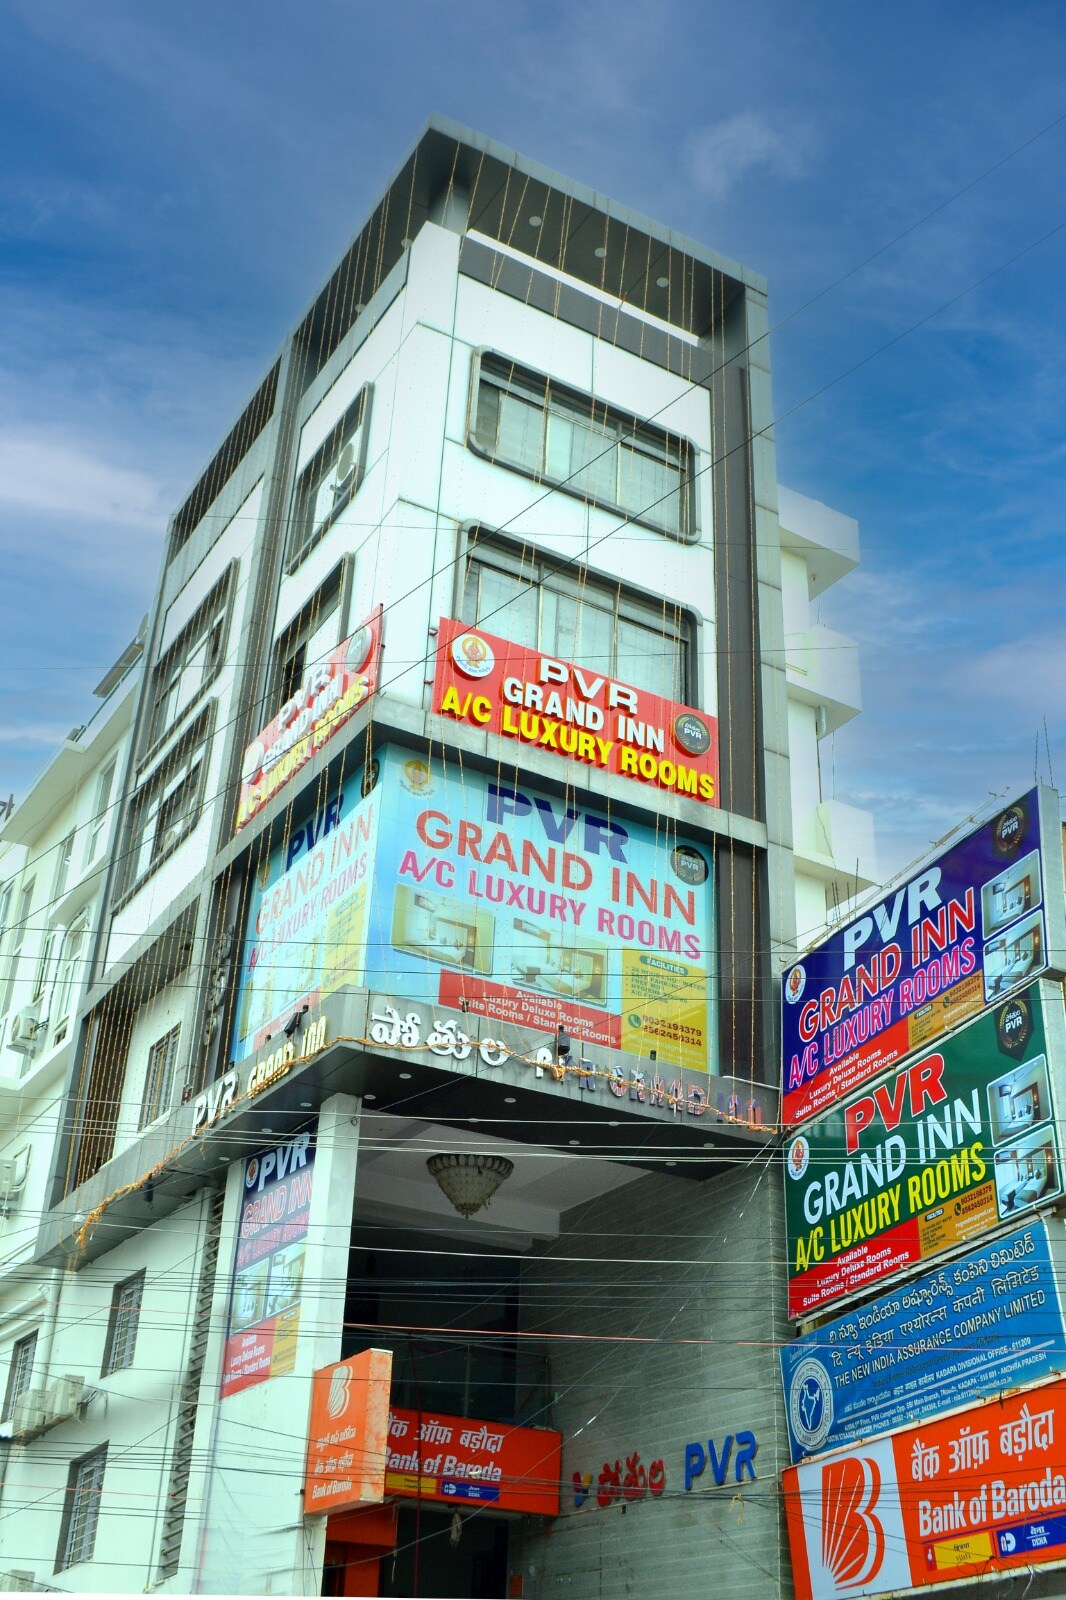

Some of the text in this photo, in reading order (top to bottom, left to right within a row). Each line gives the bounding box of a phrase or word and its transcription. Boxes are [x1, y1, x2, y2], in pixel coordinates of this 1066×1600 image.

[502, 677, 665, 753] GRAND INN
[540, 658, 638, 715] PVR
[441, 686, 715, 800] A/C LUXURY ROOMS
[684, 728, 702, 740] PVR
[287, 794, 344, 872] PVR
[486, 783, 630, 864] PVR
[1001, 821, 1019, 839] PVR
[255, 851, 326, 936] GRAND
[330, 803, 374, 873] INN
[416, 809, 696, 926] GRAND INN
[680, 860, 699, 871] PVR
[271, 893, 318, 954] LUXURY
[319, 852, 368, 911] ROOMS
[399, 850, 701, 960] A/C LUXURY ROOMS
[843, 866, 942, 971] PVR
[646, 957, 685, 974] FACILITIES
[799, 943, 902, 1044] GRAND
[911, 886, 975, 969] INN
[458, 996, 486, 1012] Suite
[488, 1005, 524, 1021] Rooms
[533, 1016, 580, 1037] Standard
[582, 1028, 616, 1044] Rooms
[482, 992, 594, 1028] Luxury Deluxe Rooms
[516, 991, 562, 1011] Available
[788, 1038, 818, 1090] A/C
[823, 1003, 894, 1066] LUXURY
[899, 937, 976, 1016] ROOMS
[1005, 1015, 1023, 1034] PVR
[795, 1101, 812, 1119] Suite
[813, 1090, 836, 1111] Rooms
[841, 1062, 872, 1090] Standard
[873, 1048, 898, 1073] Rooms
[809, 1049, 882, 1101] Luxury Deluxe Rooms
[828, 1052, 860, 1077] Available
[844, 1053, 947, 1156] PVR
[257, 1131, 311, 1193] PVR
[803, 1088, 982, 1225] GRAND INN
[241, 1185, 287, 1239] GRAND
[795, 1225, 825, 1272] A/C
[830, 1183, 902, 1255] LUXURY
[908, 1140, 987, 1214] ROOMS
[252, 1226, 282, 1259] LUXURY
[816, 1246, 892, 1288] Luxury Deluxe Rooms
[836, 1246, 869, 1267] Available
[803, 1290, 820, 1307] Suite
[820, 1283, 844, 1302] Rooms
[849, 1260, 882, 1285] Standard
[883, 1250, 910, 1270] Rooms
[859, 1302, 900, 1329] ఇండియా
[991, 1232, 1035, 1269] లిమిటెడ్
[834, 1371, 850, 1389] THE
[851, 1362, 871, 1381] NEW
[872, 1352, 896, 1373] INDIA
[897, 1328, 953, 1364] ASSURANCE
[953, 1306, 1001, 1338] COMPANY
[1003, 1289, 1046, 1319] LIMITED
[866, 1328, 895, 1354] इंडिया
[935, 1366, 957, 1379] KADAPA
[957, 1354, 988, 1371] DIVISIONAL
[987, 1345, 1008, 1360] OFFICE
[957, 1377, 978, 1389] KADAPA
[1021, 1352, 1047, 1367] PRADESH
[423, 1453, 443, 1474] of
[442, 1455, 503, 1482] Baroda
[459, 1425, 506, 1453] बड़ौदा
[685, 1429, 758, 1492] PVR
[910, 1437, 941, 1482] बैंक
[998, 1402, 1056, 1462] बड़ौदा
[312, 1476, 353, 1500] Bank of Baroda
[918, 1466, 1066, 1537] Bank of Baroda
[1031, 1536, 1049, 1547] DENA
